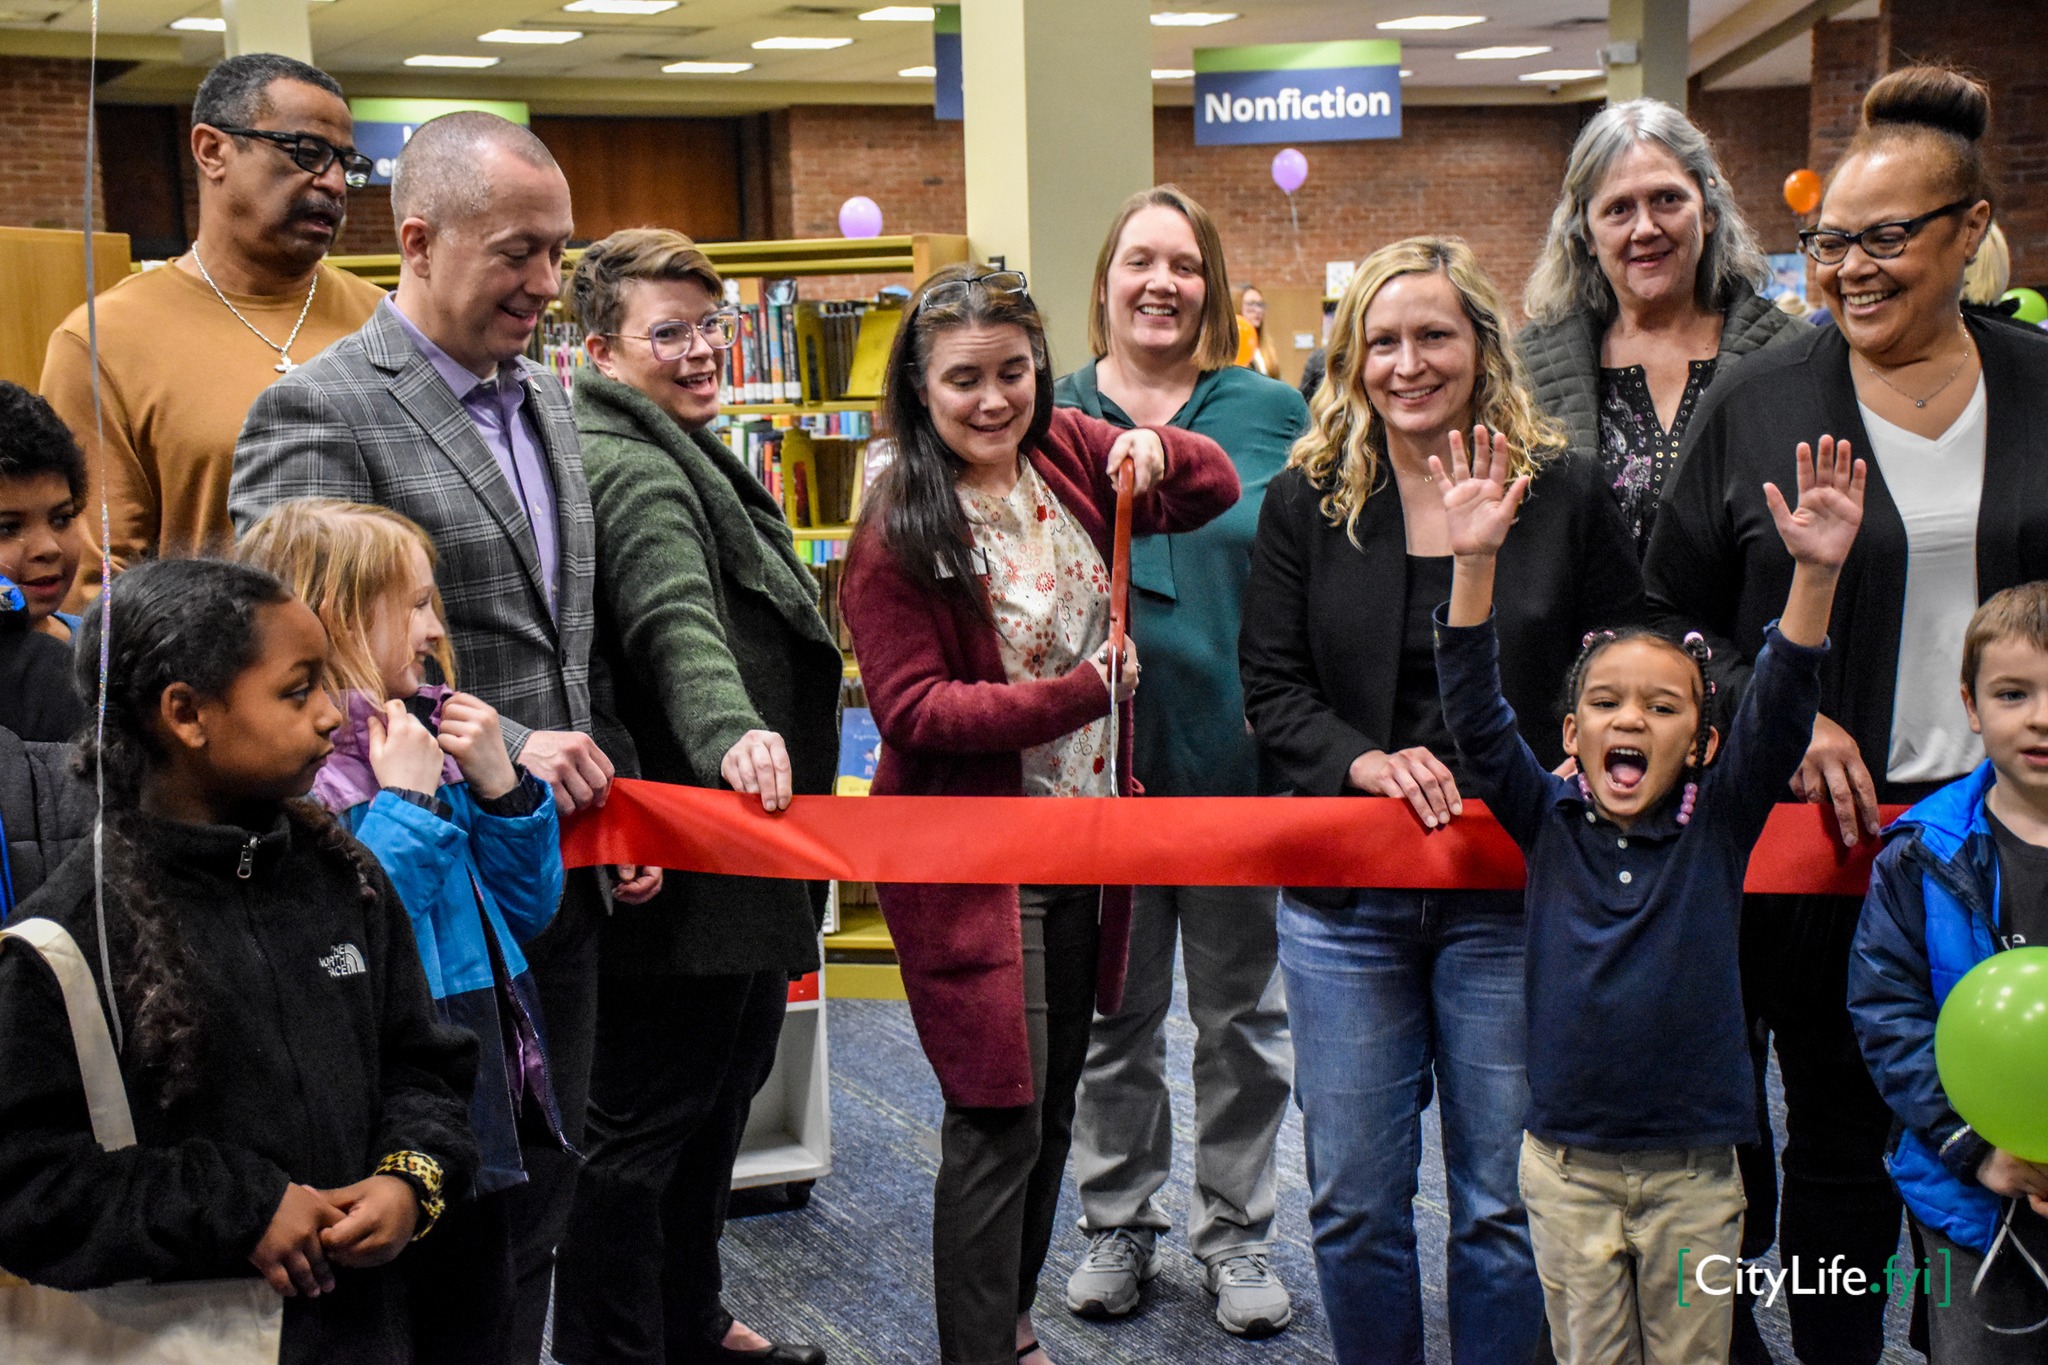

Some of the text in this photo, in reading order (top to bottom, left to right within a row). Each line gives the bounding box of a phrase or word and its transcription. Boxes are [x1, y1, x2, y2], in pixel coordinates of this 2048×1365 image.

[1205, 86, 1391, 123] Nonfiction
[331, 944, 345, 955] THE
[319, 955, 345, 967] NORTH
[328, 965, 347, 977] FACE
